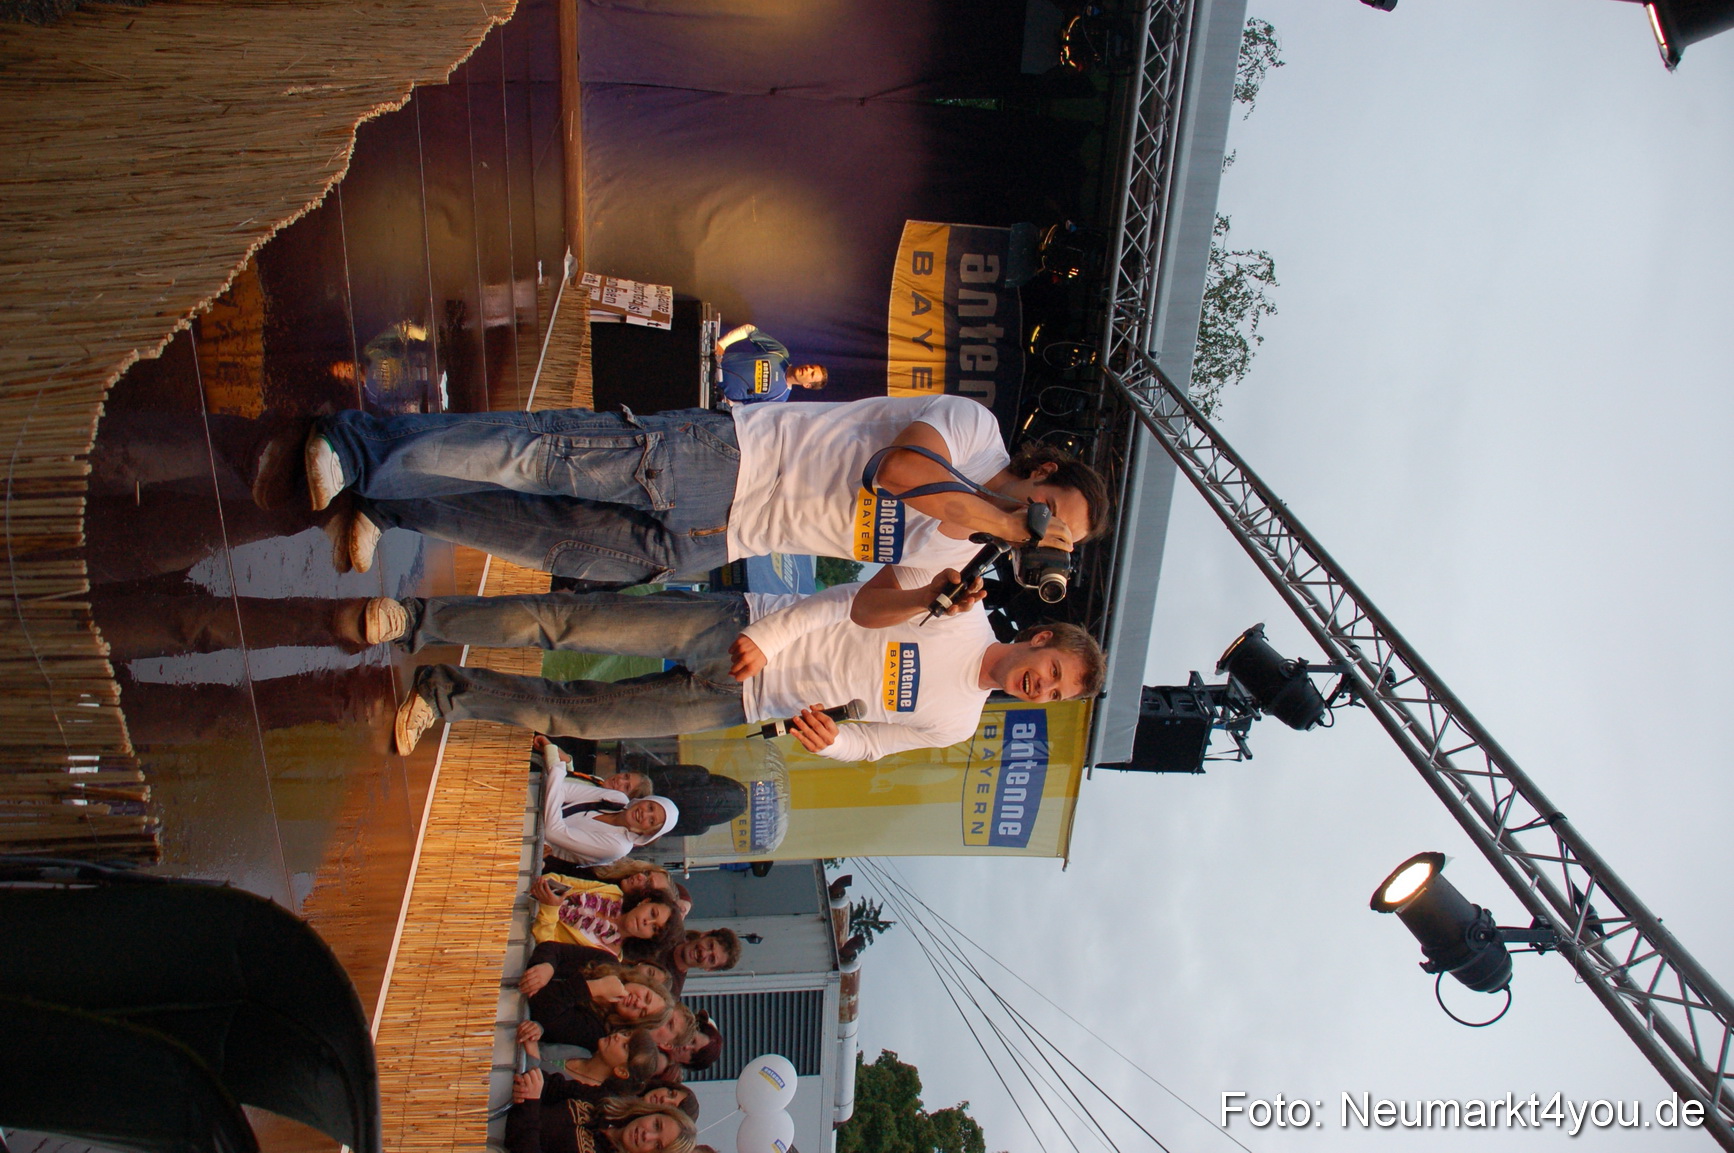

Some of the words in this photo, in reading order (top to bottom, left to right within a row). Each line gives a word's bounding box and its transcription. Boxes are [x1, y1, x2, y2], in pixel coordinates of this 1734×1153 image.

[912, 251, 934, 390] BAYE
[958, 254, 1004, 408] anten
[861, 498, 872, 560] BAYERN
[878, 500, 898, 562] antenne
[888, 650, 896, 706] BAYERN
[900, 650, 916, 708] antenne
[971, 725, 997, 834] BAYERN
[998, 723, 1037, 835] antenne
